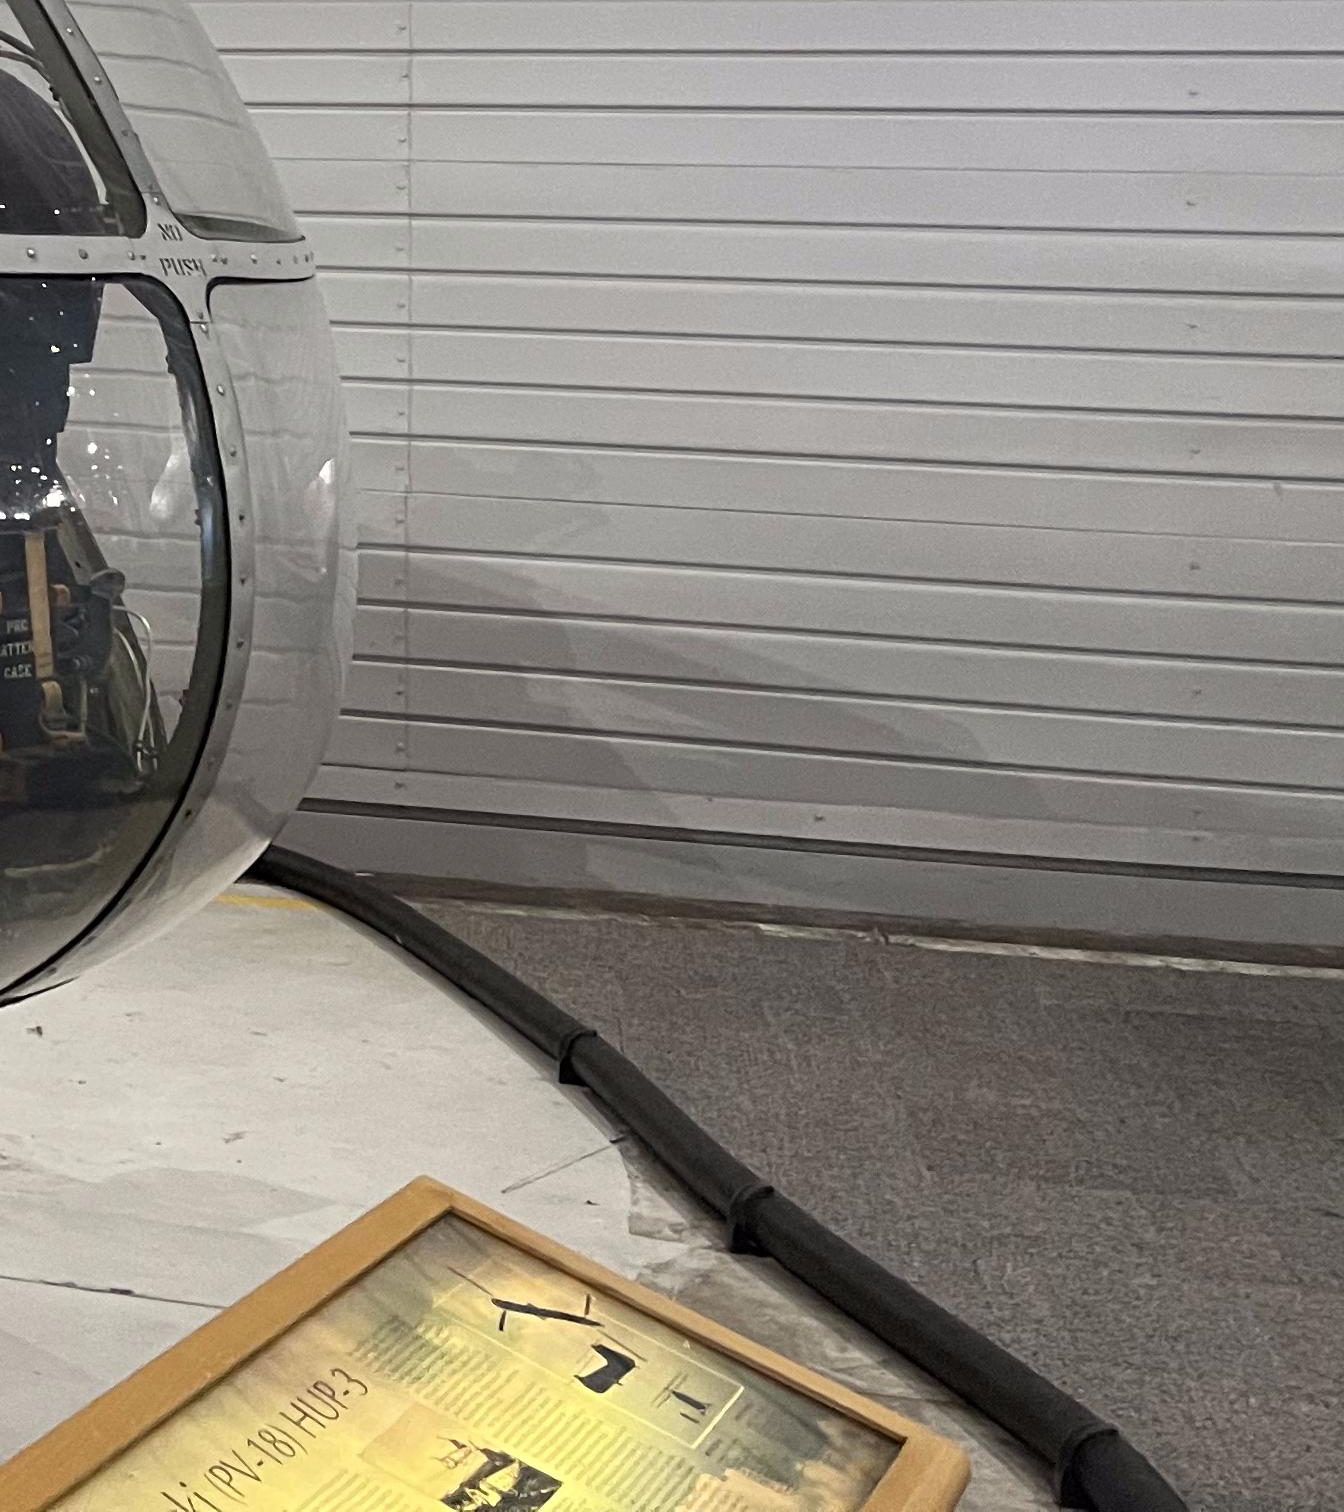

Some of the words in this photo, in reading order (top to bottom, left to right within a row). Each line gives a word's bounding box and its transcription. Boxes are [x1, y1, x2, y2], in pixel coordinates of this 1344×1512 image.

[159, 257, 207, 277] PUSH
[203, 1423, 308, 1505] (PV-18)
[279, 1367, 369, 1439] HUP-3
